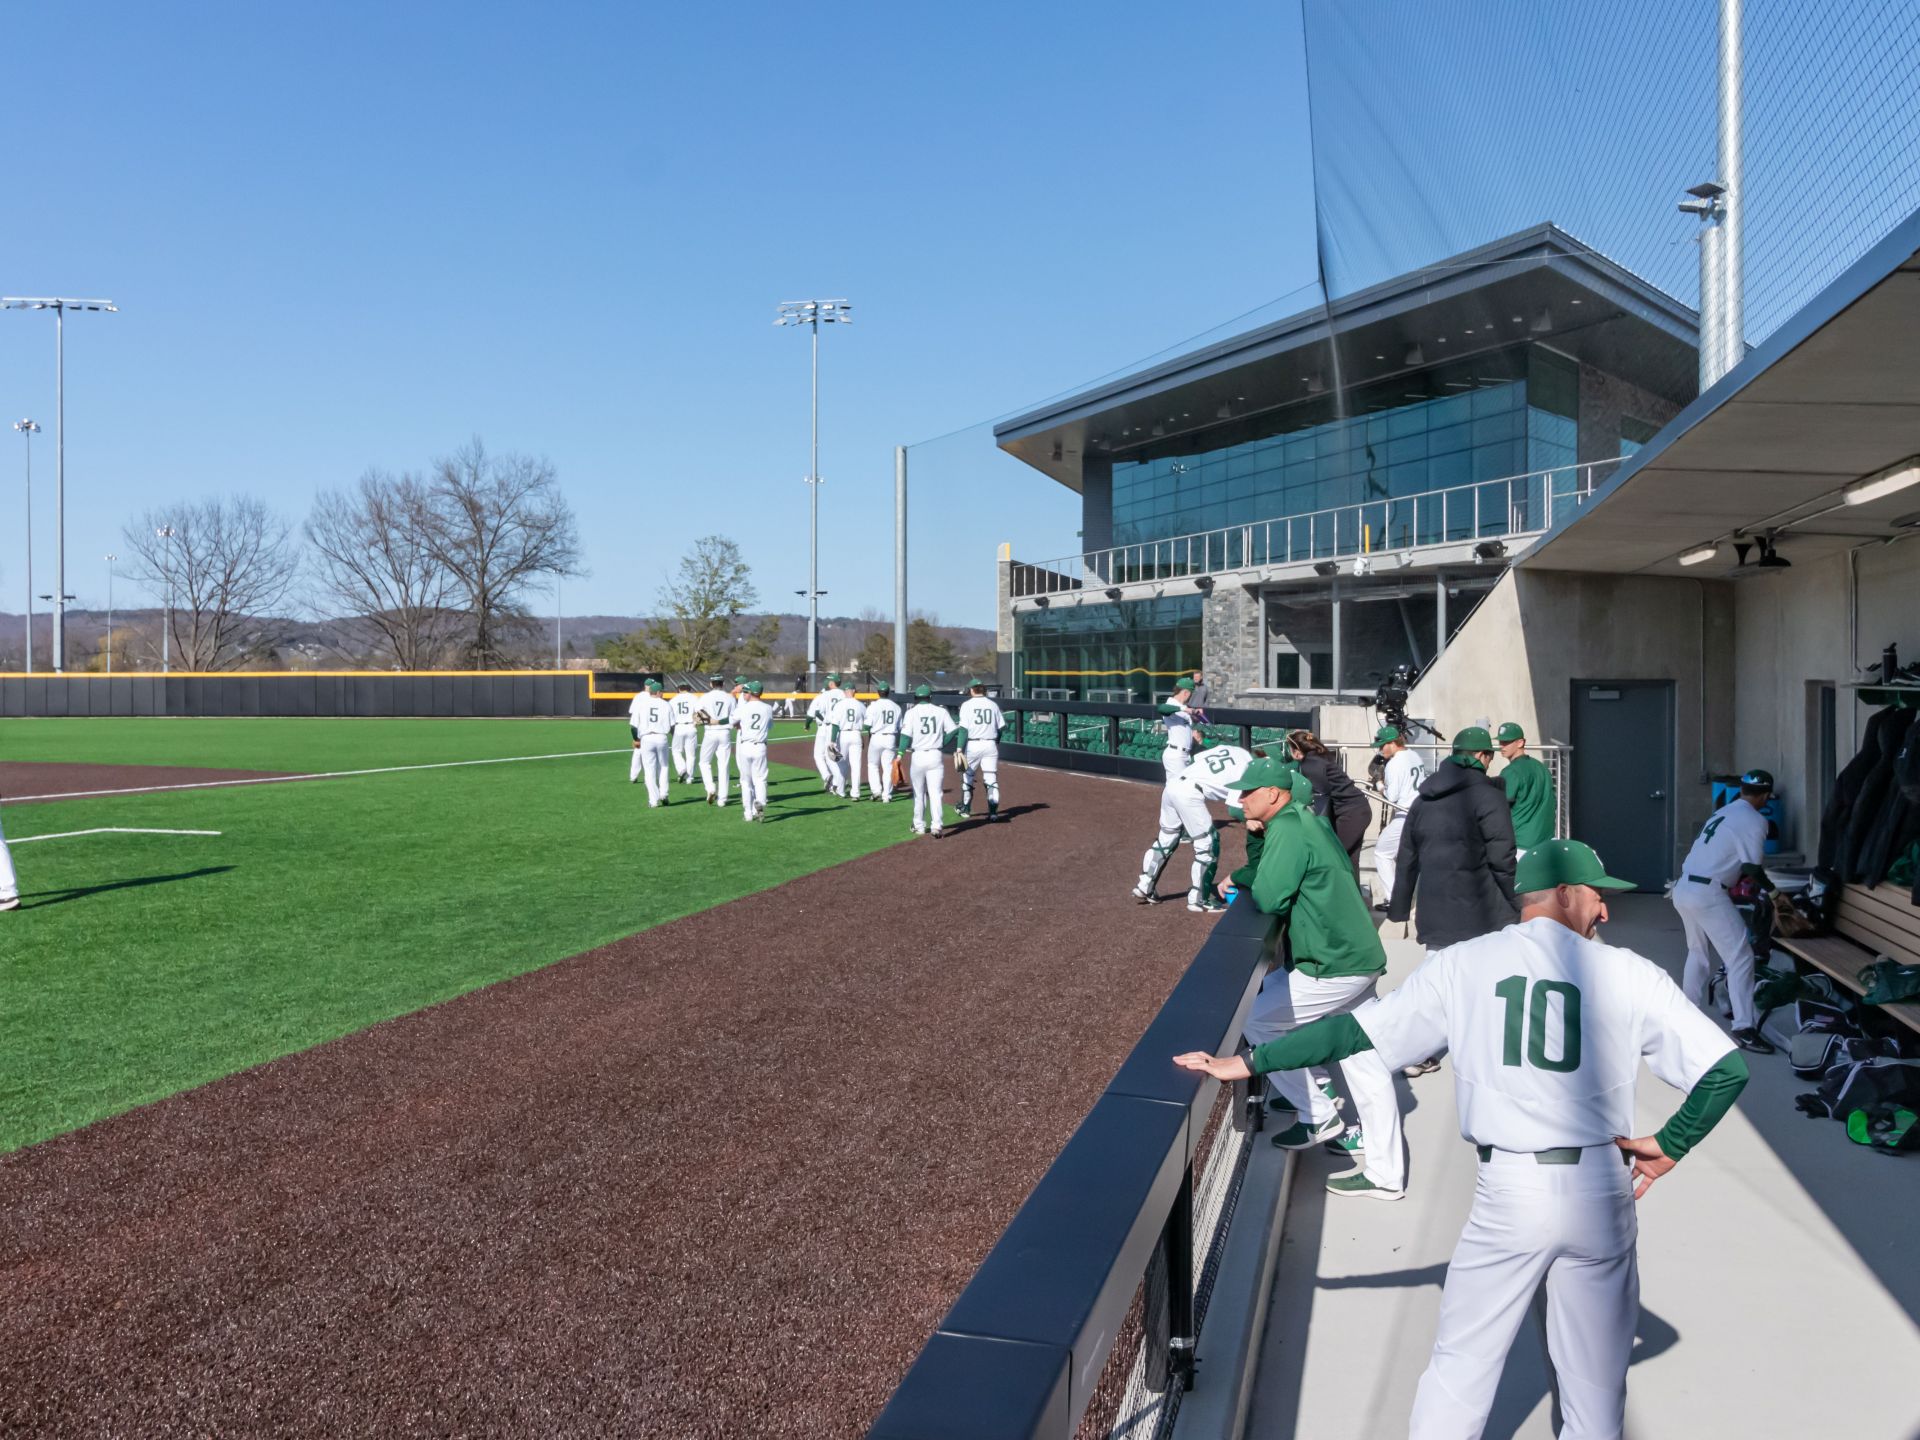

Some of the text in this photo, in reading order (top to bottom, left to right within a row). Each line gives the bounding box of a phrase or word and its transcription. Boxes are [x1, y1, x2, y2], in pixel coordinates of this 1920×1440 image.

[649, 708, 659, 722] 5
[677, 701, 689, 714] 15
[715, 701, 724, 716] 7
[847, 708, 855, 722] 8
[750, 713, 761, 729] 2
[882, 710, 895, 725] 18
[973, 708, 992, 725] 30
[919, 715, 937, 735] 31
[1204, 748, 1236, 774] 25
[1495, 974, 1582, 1073] 10
